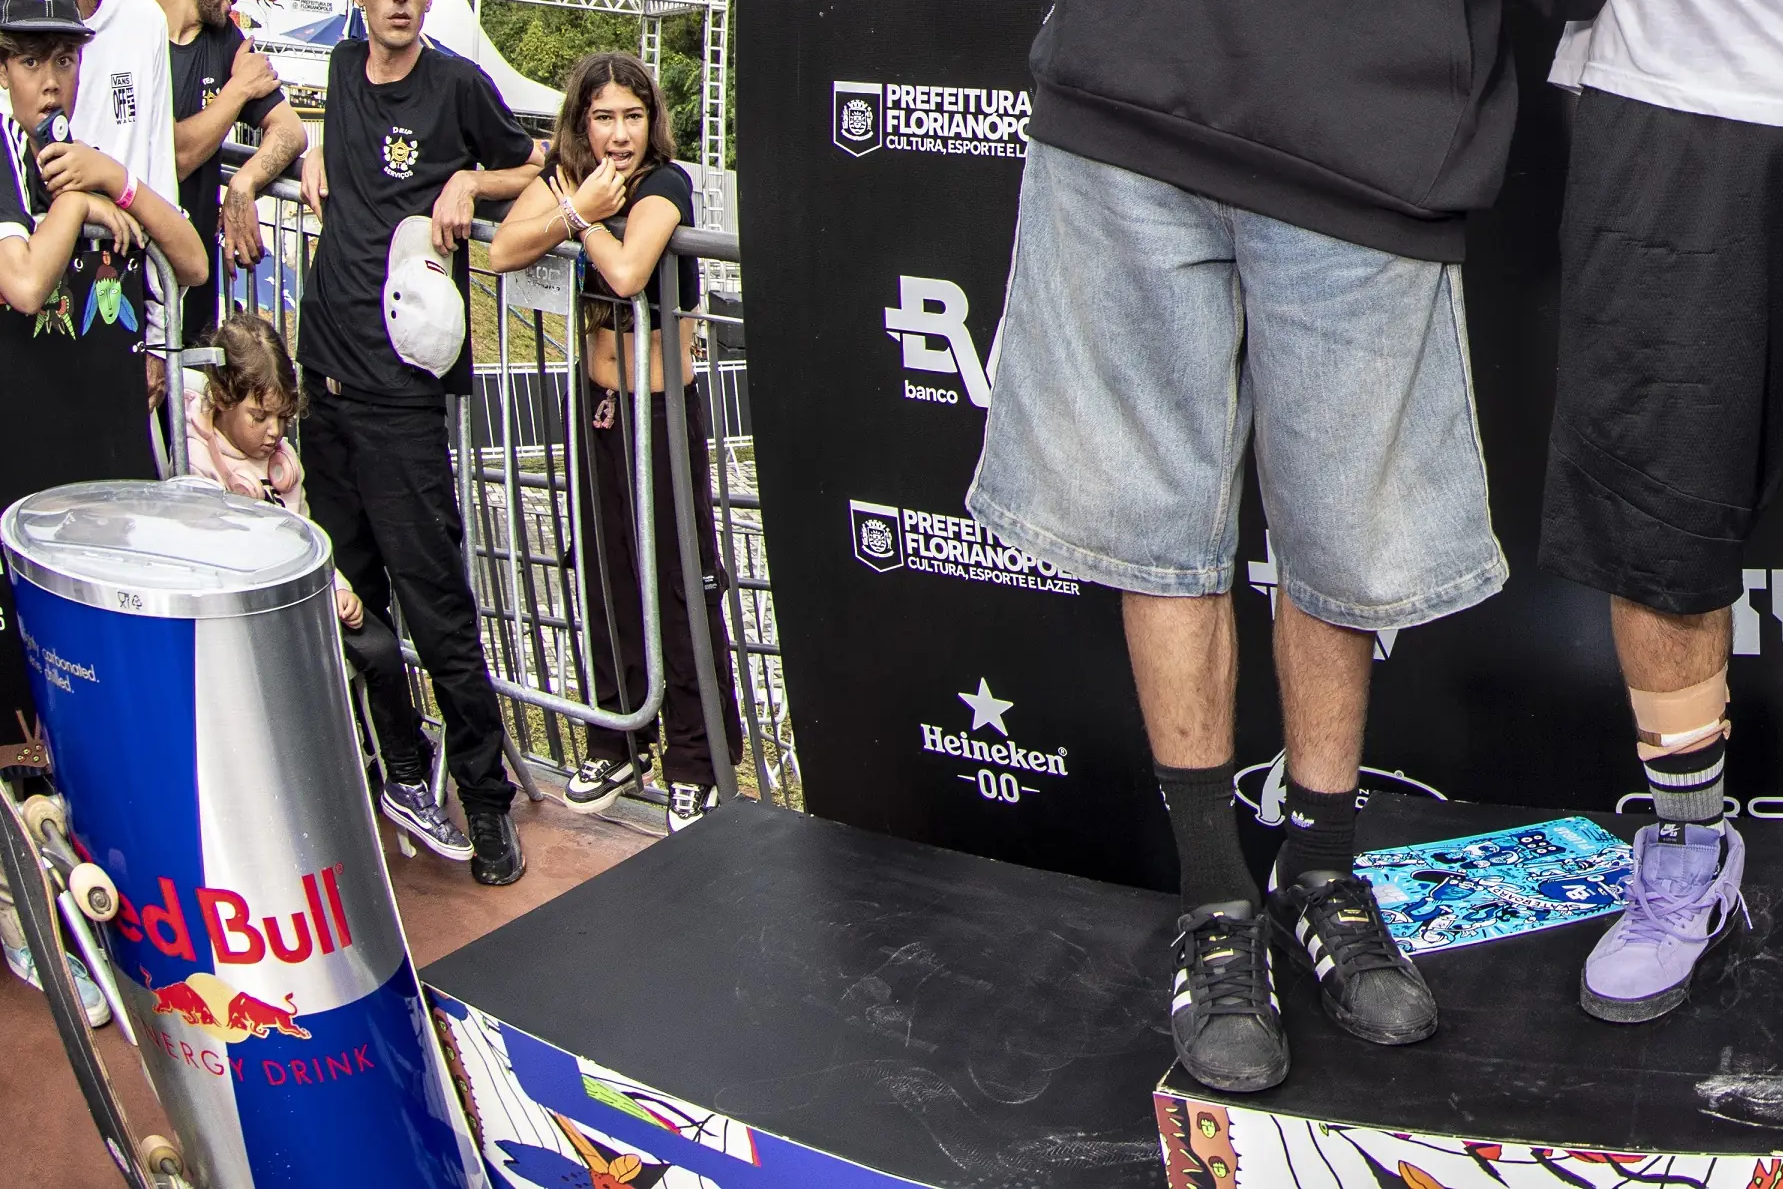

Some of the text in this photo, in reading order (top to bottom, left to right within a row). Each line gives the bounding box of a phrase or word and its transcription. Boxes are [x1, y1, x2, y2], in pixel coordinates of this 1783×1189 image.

[112, 74, 130, 86] VANS
[886, 83, 1032, 116] PREFEITURA
[886, 109, 1032, 142] FLORIANÓPO
[886, 135, 946, 155] CULTURA,
[948, 140, 1006, 157] ESPORTE
[1007, 143, 1015, 157] E
[904, 380, 958, 404] banco
[903, 509, 1005, 546] PREFEIT
[905, 533, 1094, 584] FLORIANÓPO
[908, 557, 1080, 595] CULTURA, ESPORTE E LAZER
[42, 647, 100, 683] carbonated.
[920, 723, 1068, 776] Heineken
[100, 863, 353, 964] ed Bull
[140, 1021, 375, 1086] NERGY DRINK
